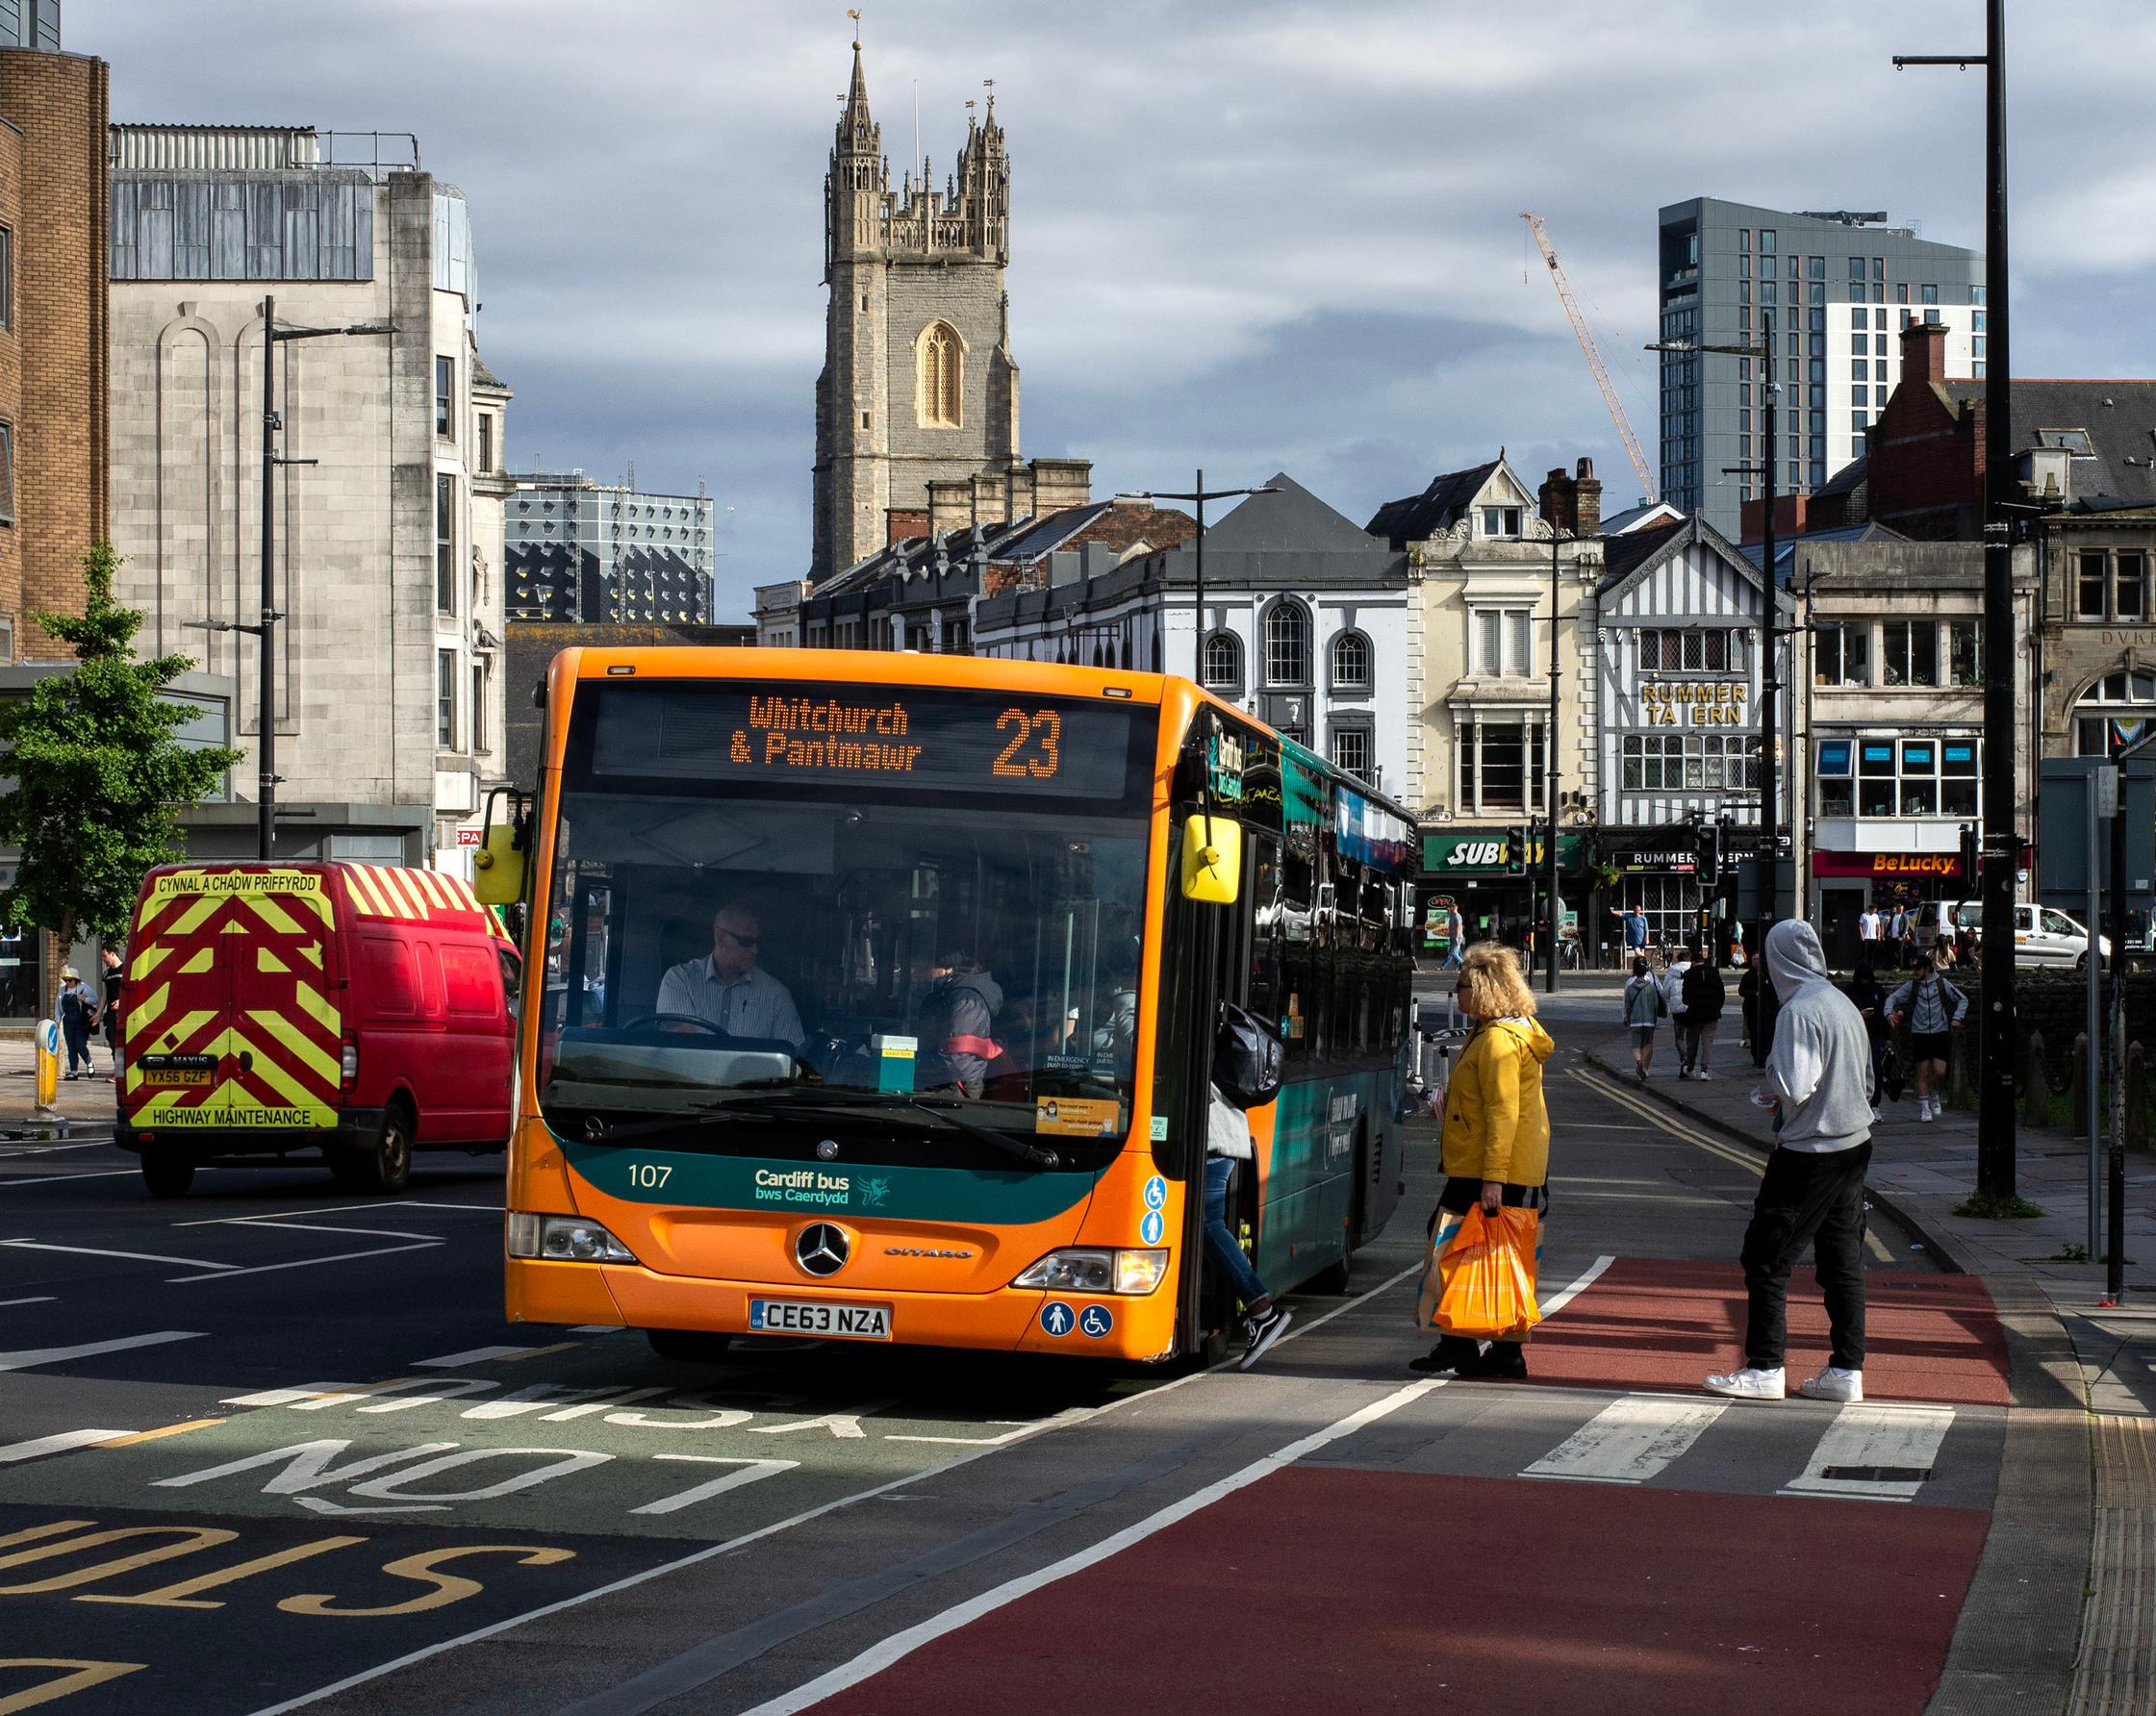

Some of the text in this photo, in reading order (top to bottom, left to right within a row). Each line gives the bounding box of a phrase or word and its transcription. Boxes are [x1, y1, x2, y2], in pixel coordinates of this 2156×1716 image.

[1641, 684, 1748, 704] RUMMER
[749, 695, 908, 736] Whitchurch
[730, 730, 923, 770] & Pantmawr
[992, 708, 1062, 778] 23
[1635, 853, 1695, 864] RUMMER
[159, 875, 316, 893] CYNNAL A CHADW PRIFFYRDD
[151, 1070, 208, 1084] YX56 GZF
[153, 1108, 311, 1125] HIGHWAY MAINTENANCE
[628, 1164, 672, 1189] 107
[754, 1169, 850, 1191] Cardiff bus
[755, 1187, 849, 1206] bws Caerdydd
[883, 1246, 974, 1259] CITARO
[766, 1304, 831, 1331] CE63
[838, 1308, 886, 1334] NZA
[0, 1519, 577, 1617] STO
